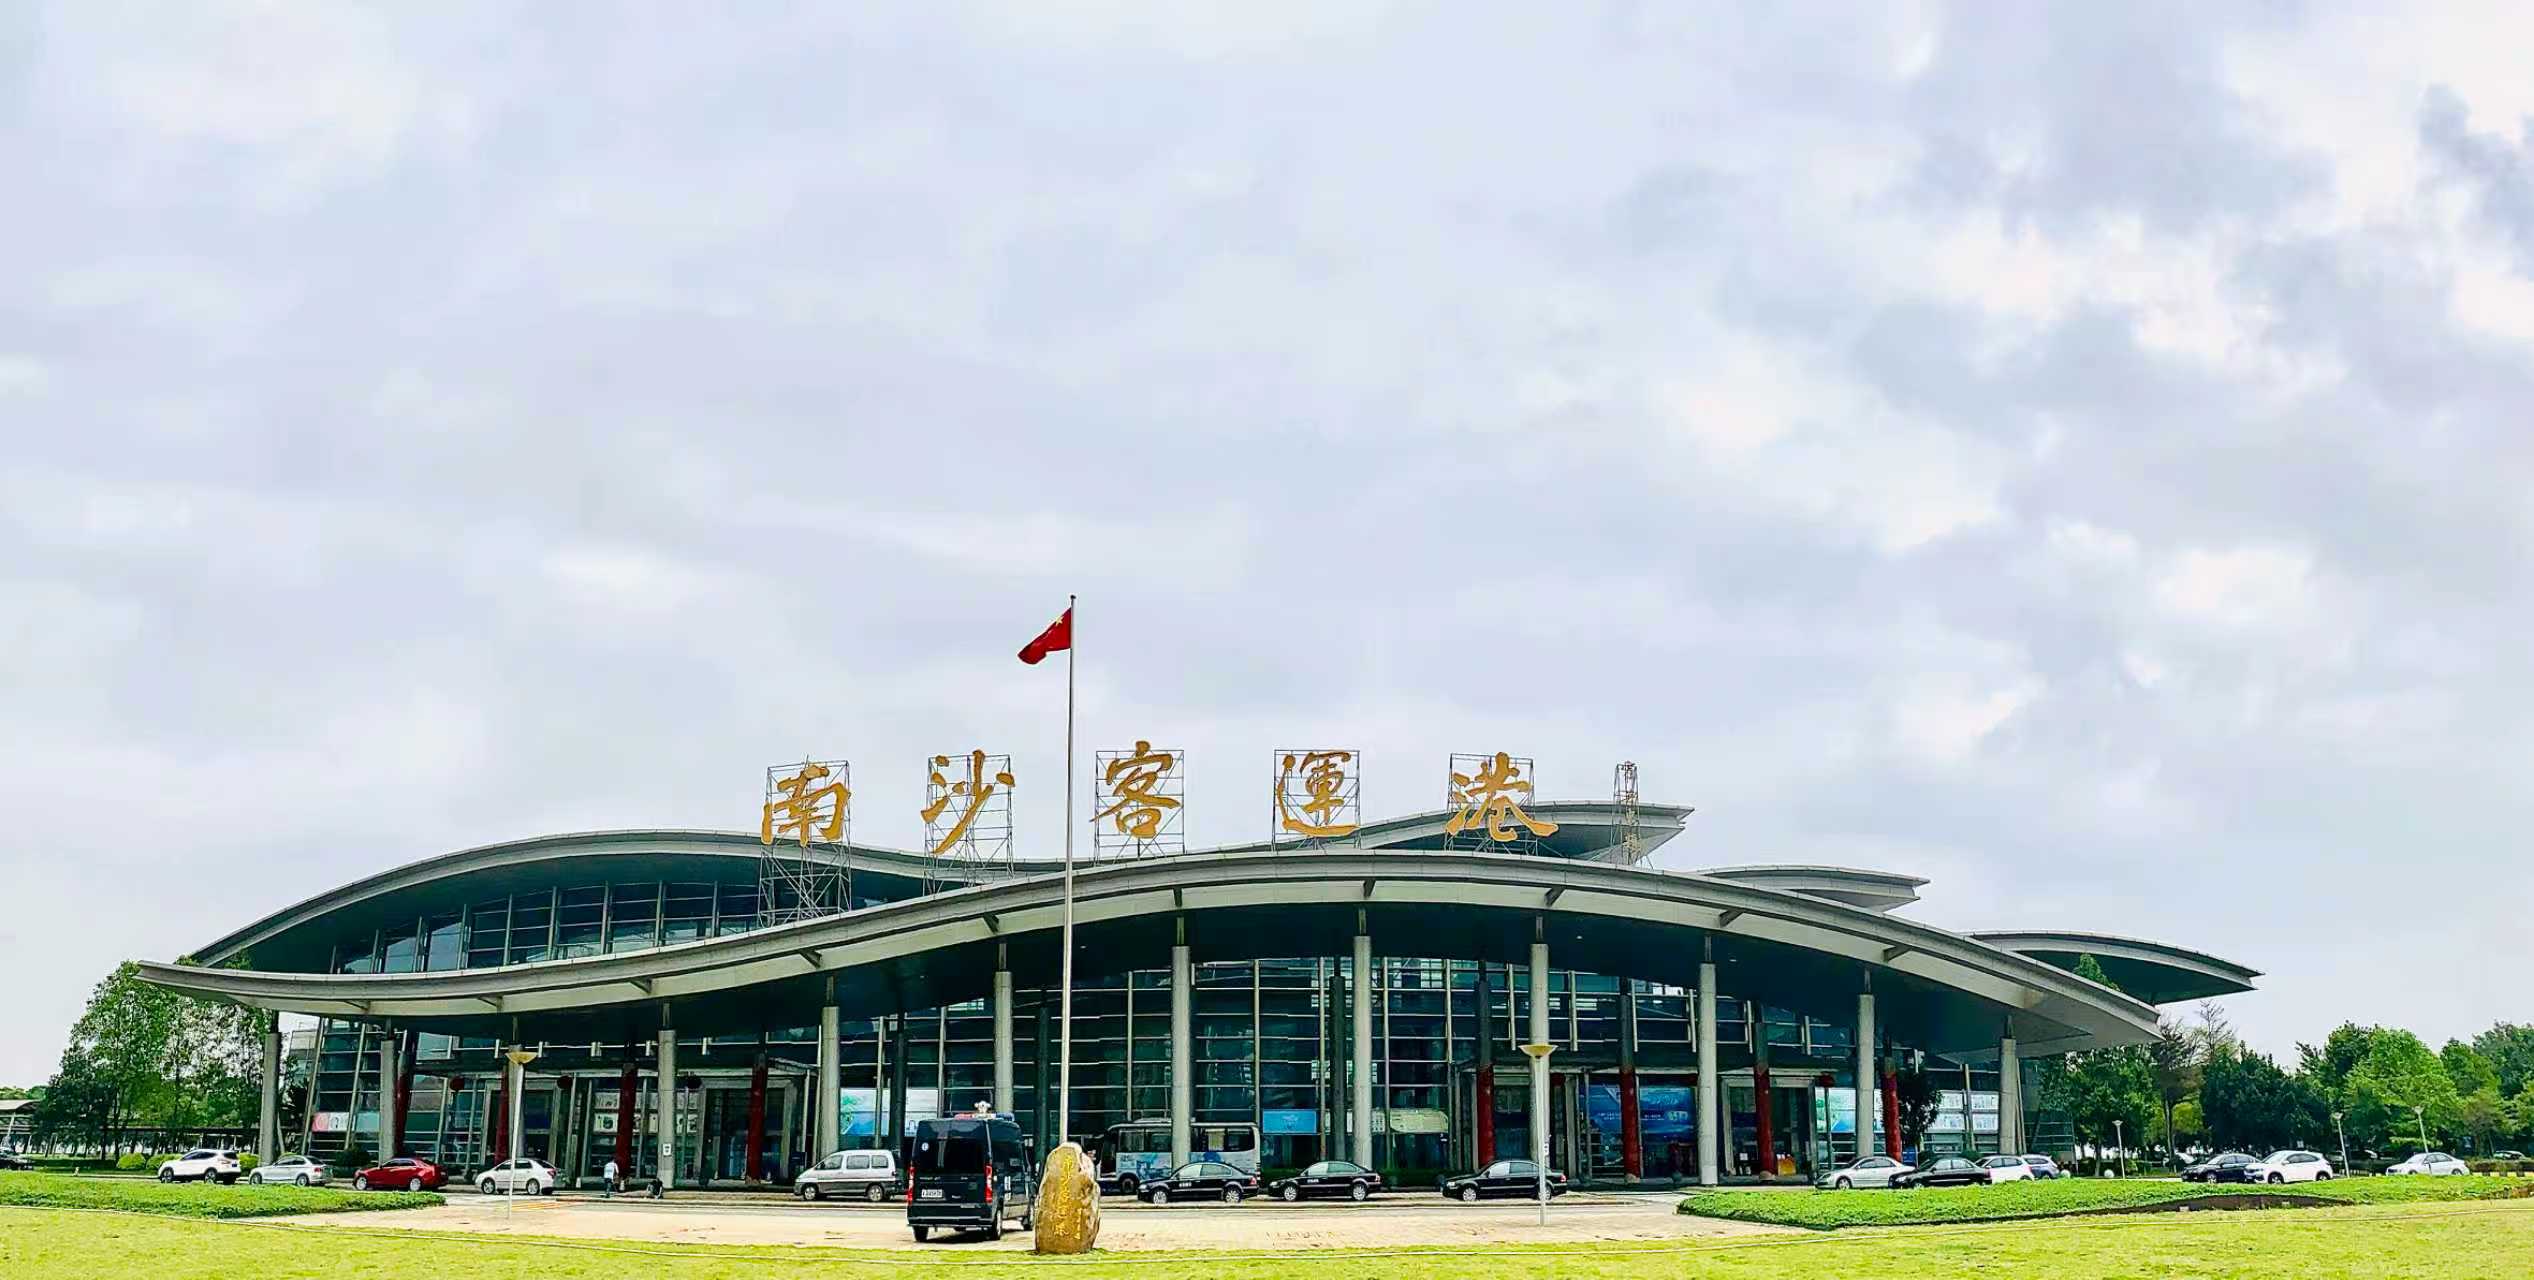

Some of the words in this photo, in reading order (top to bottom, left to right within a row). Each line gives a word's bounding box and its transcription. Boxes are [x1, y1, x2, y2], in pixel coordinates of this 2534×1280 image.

[761, 740, 1556, 854] 南沙客運港
